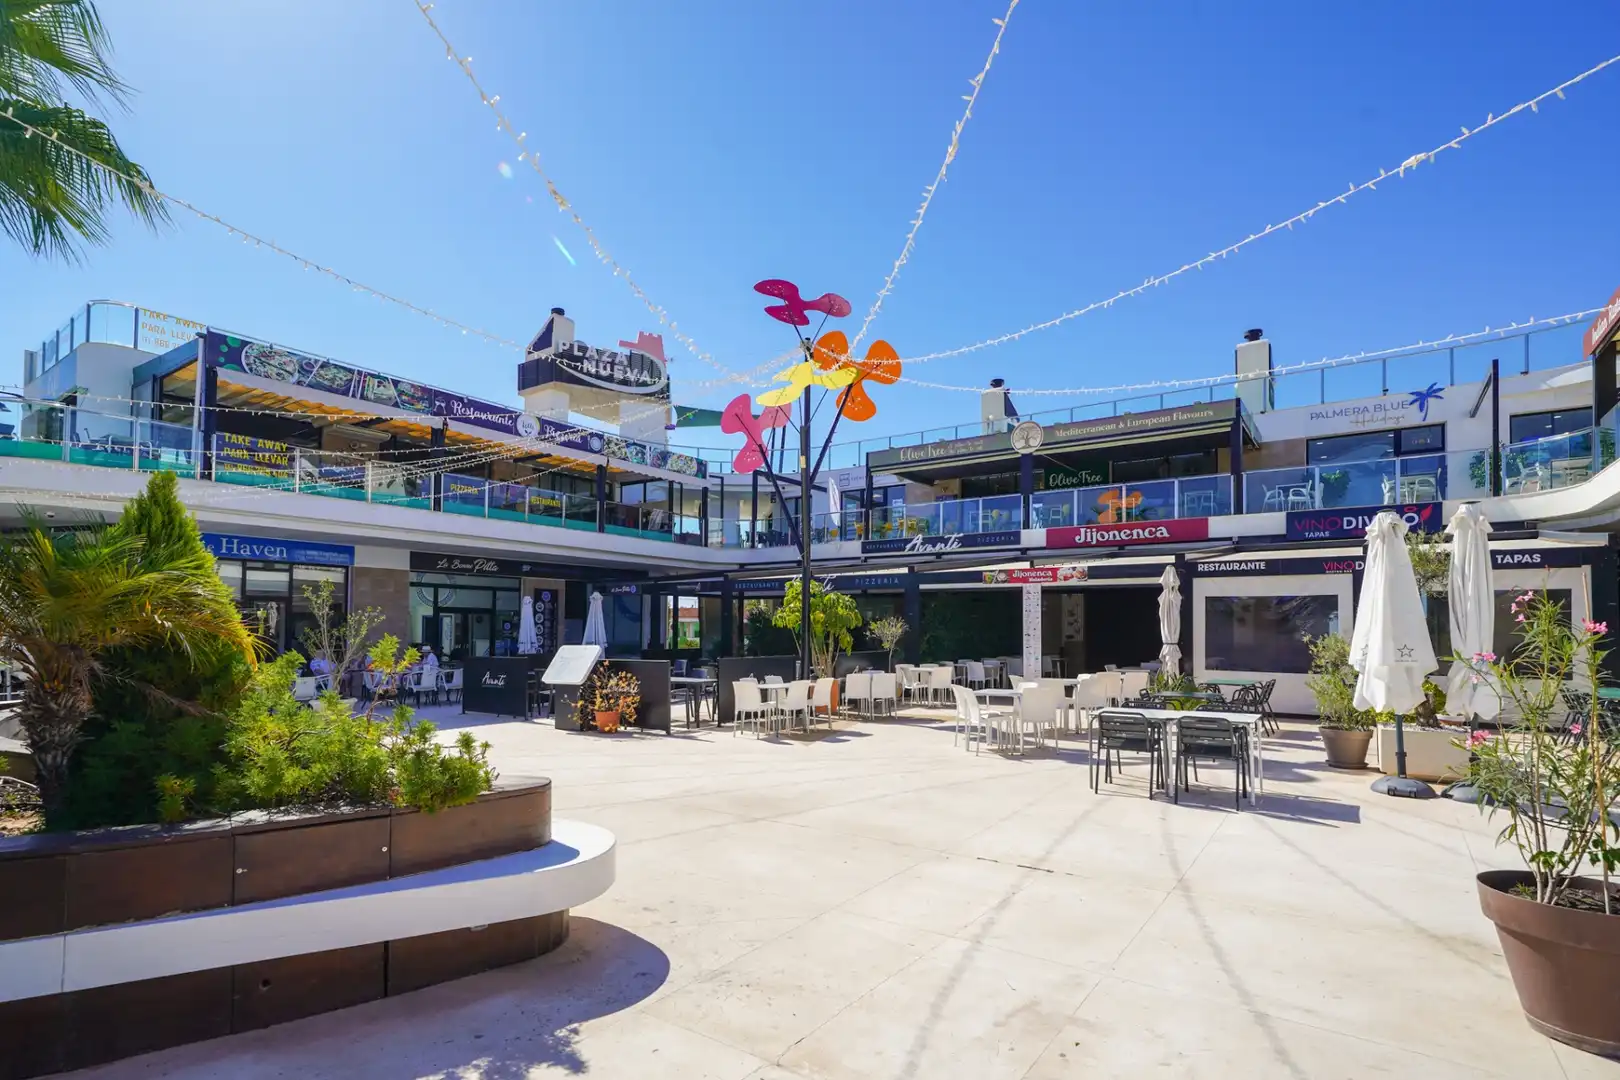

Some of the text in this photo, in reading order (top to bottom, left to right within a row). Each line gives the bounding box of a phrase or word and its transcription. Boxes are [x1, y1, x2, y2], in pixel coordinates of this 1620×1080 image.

[142, 308, 206, 330] TAKE AWAY
[141, 321, 197, 342] PARA LLEV
[559, 340, 628, 365] PLAZA
[583, 359, 651, 383] NUEVA
[451, 400, 515, 427] Restaurante
[1310, 399, 1410, 420] PALMERA BLUE
[1054, 423, 1116, 437] Mediterranean
[1127, 415, 1171, 428] European
[1173, 409, 1214, 422] Flavours
[224, 432, 288, 452] TAKE AWAY
[223, 447, 289, 467] PARA LLEVAR
[904, 533, 965, 553] Avanti
[1074, 526, 1170, 545] Jijonenca
[1304, 531, 1330, 539] TAPAS
[220, 537, 287, 558] Haven
[436, 558, 449, 569] La
[1197, 561, 1266, 572] RESTAURANTE
[1495, 553, 1541, 564] TAPAS
[1012, 569, 1053, 578] Jijonenca
